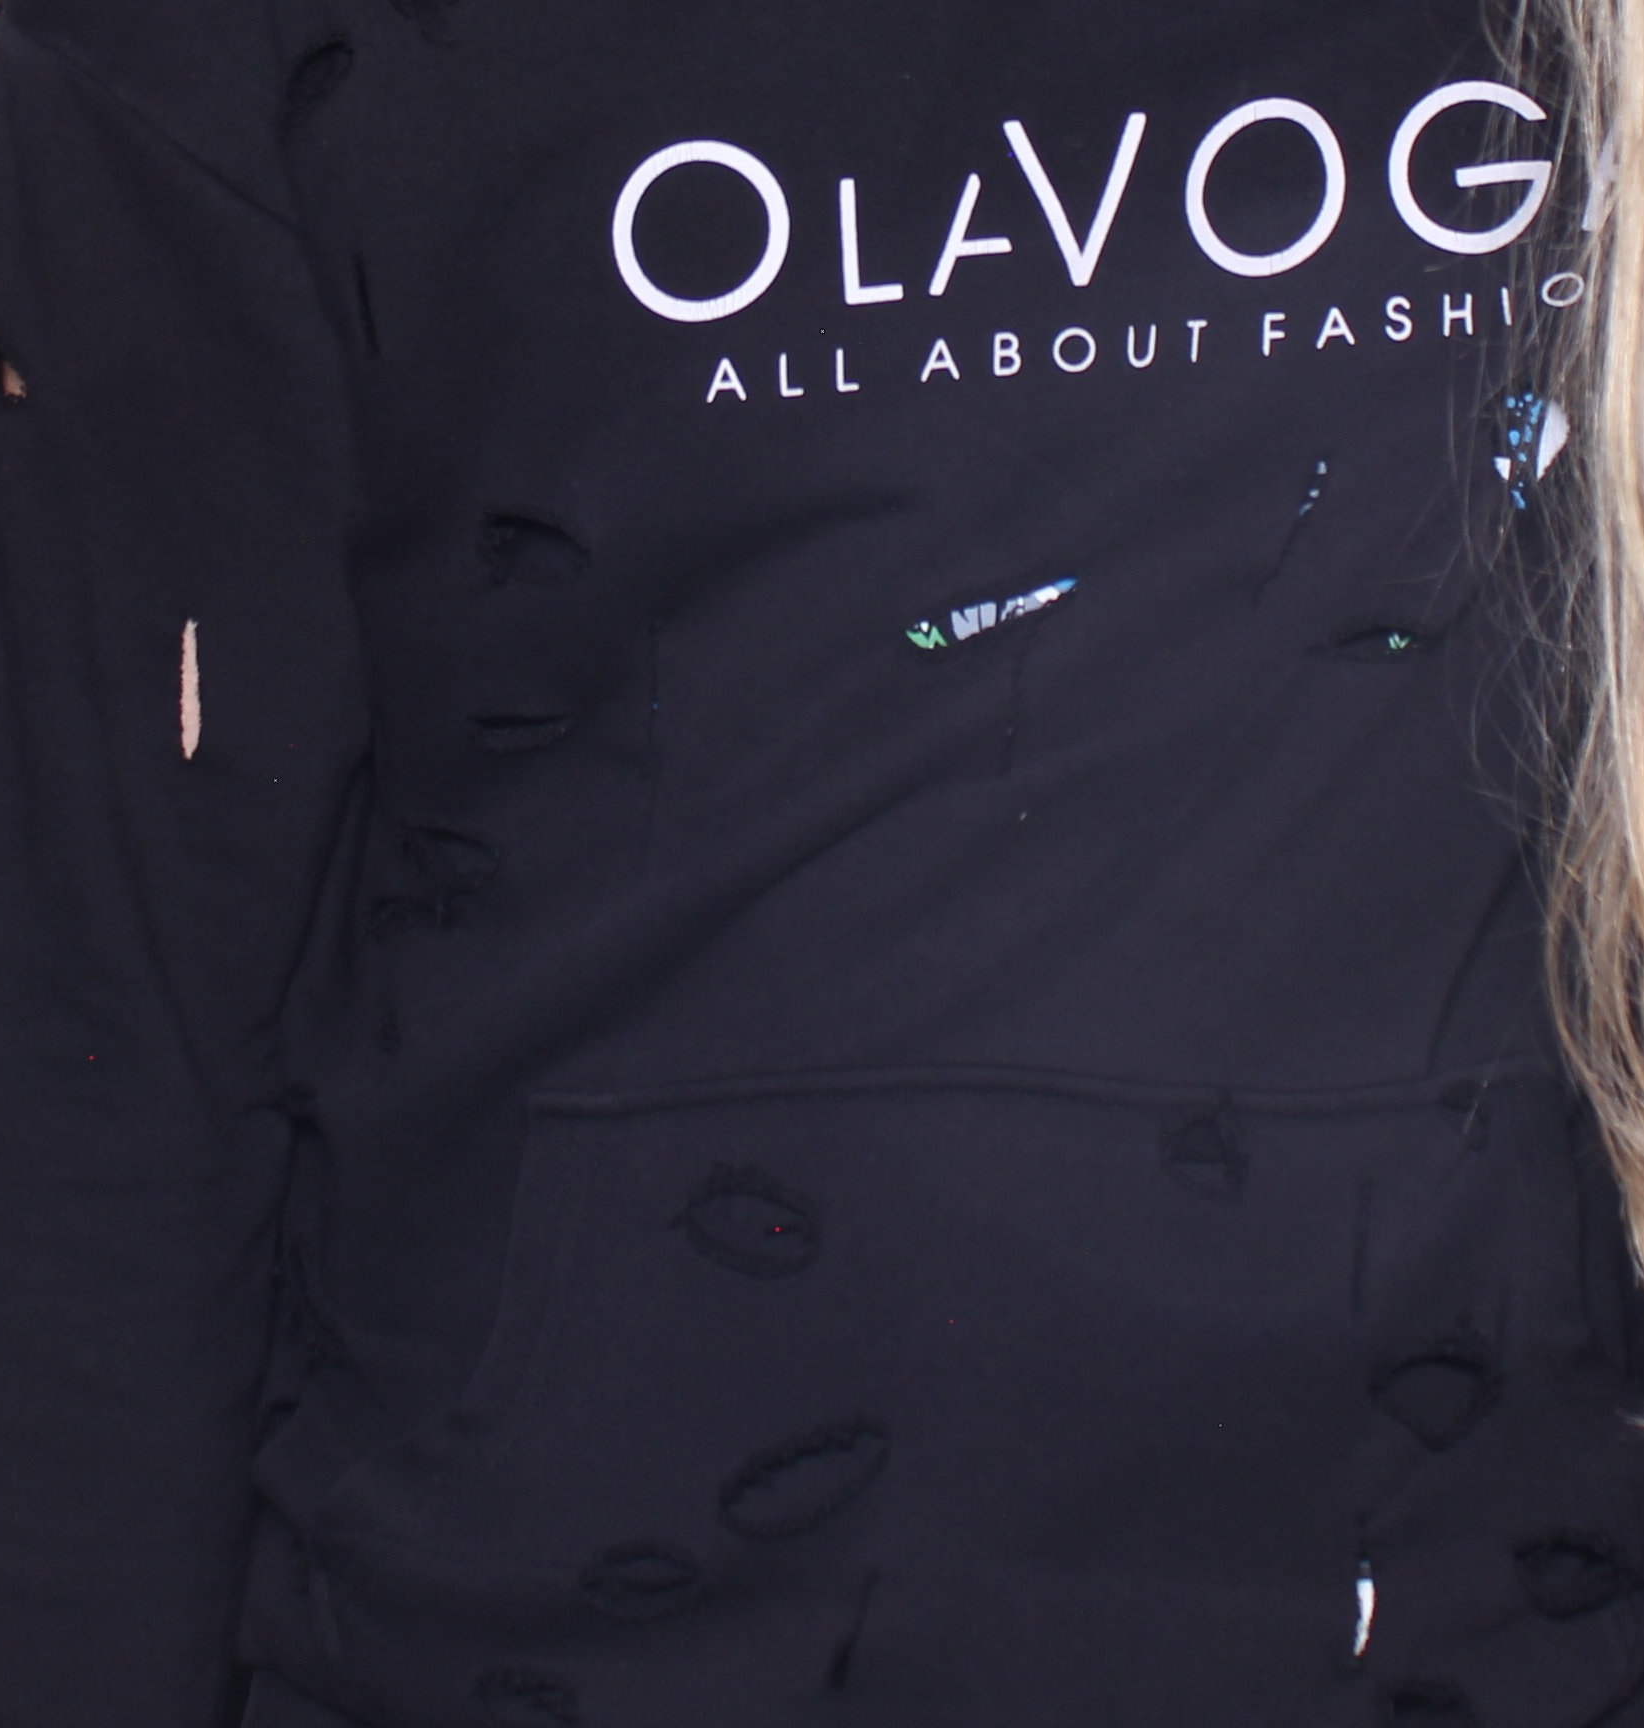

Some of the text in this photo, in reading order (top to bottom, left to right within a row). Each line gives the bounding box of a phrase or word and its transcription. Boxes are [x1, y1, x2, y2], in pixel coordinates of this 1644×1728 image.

[706, 271, 1585, 403] ALL ABOUT FASHIO
